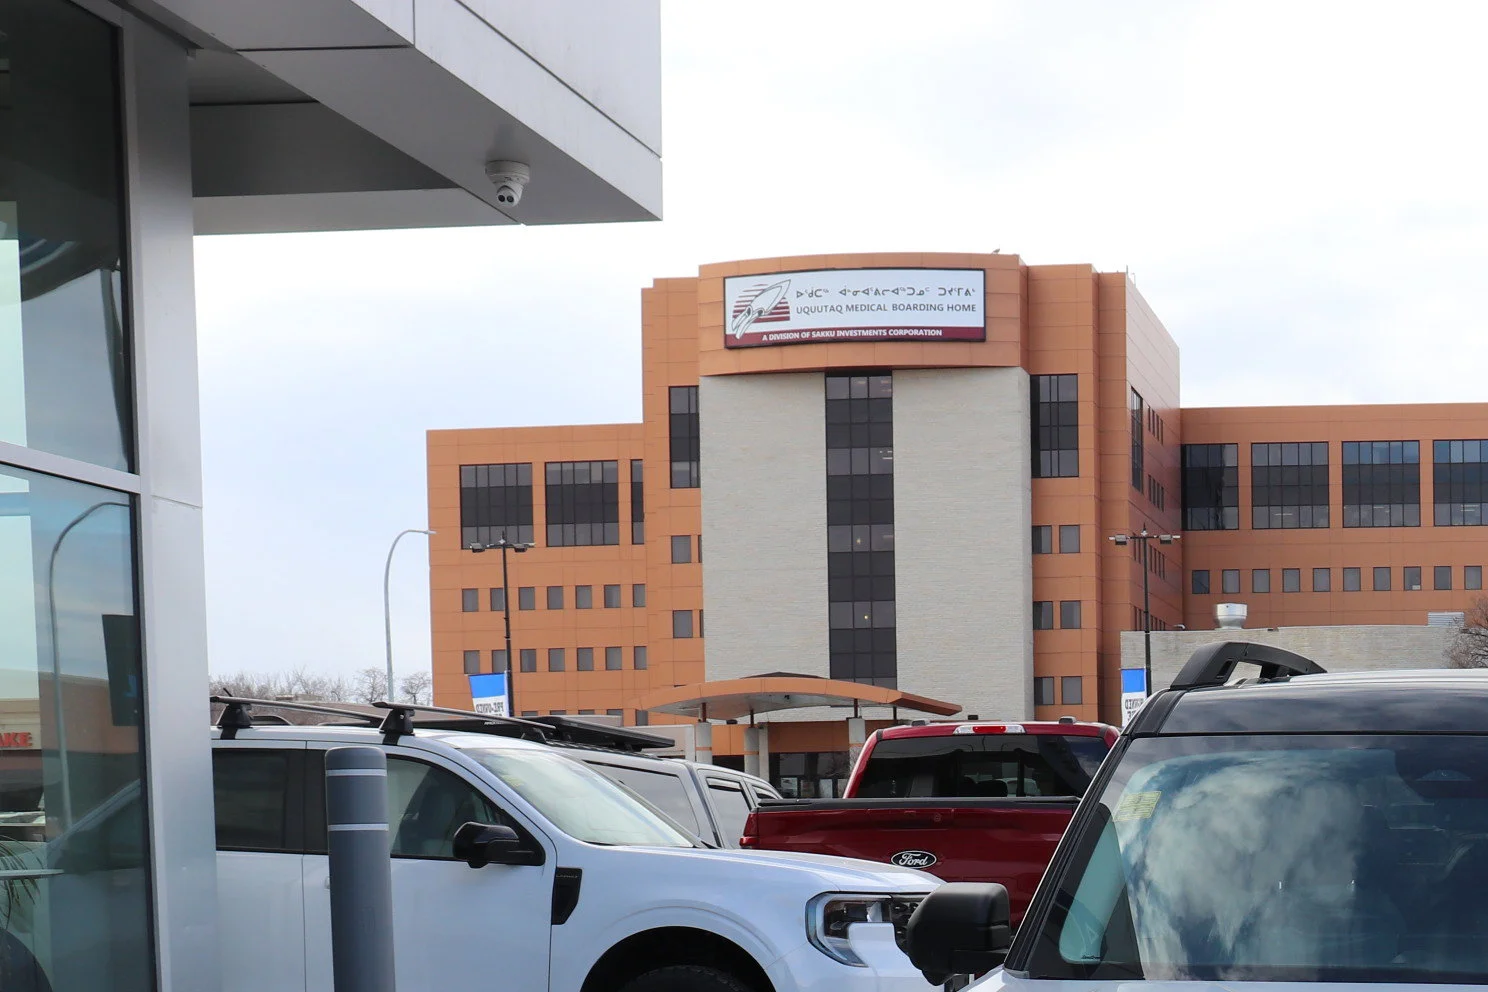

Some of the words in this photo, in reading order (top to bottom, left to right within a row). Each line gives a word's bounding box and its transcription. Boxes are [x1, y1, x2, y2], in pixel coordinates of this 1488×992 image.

[796, 304, 844, 315] UQUUTAQ
[845, 303, 888, 312] MEDICAL
[892, 303, 944, 312] BOARDING
[947, 304, 976, 312] HOME
[768, 332, 800, 341] DIVISION
[801, 331, 811, 339] OF
[812, 330, 836, 338] SAKKU
[837, 329, 887, 337] INVESTMENTS
[888, 328, 943, 336] CORPORATION
[898, 853, 929, 866] Ford
